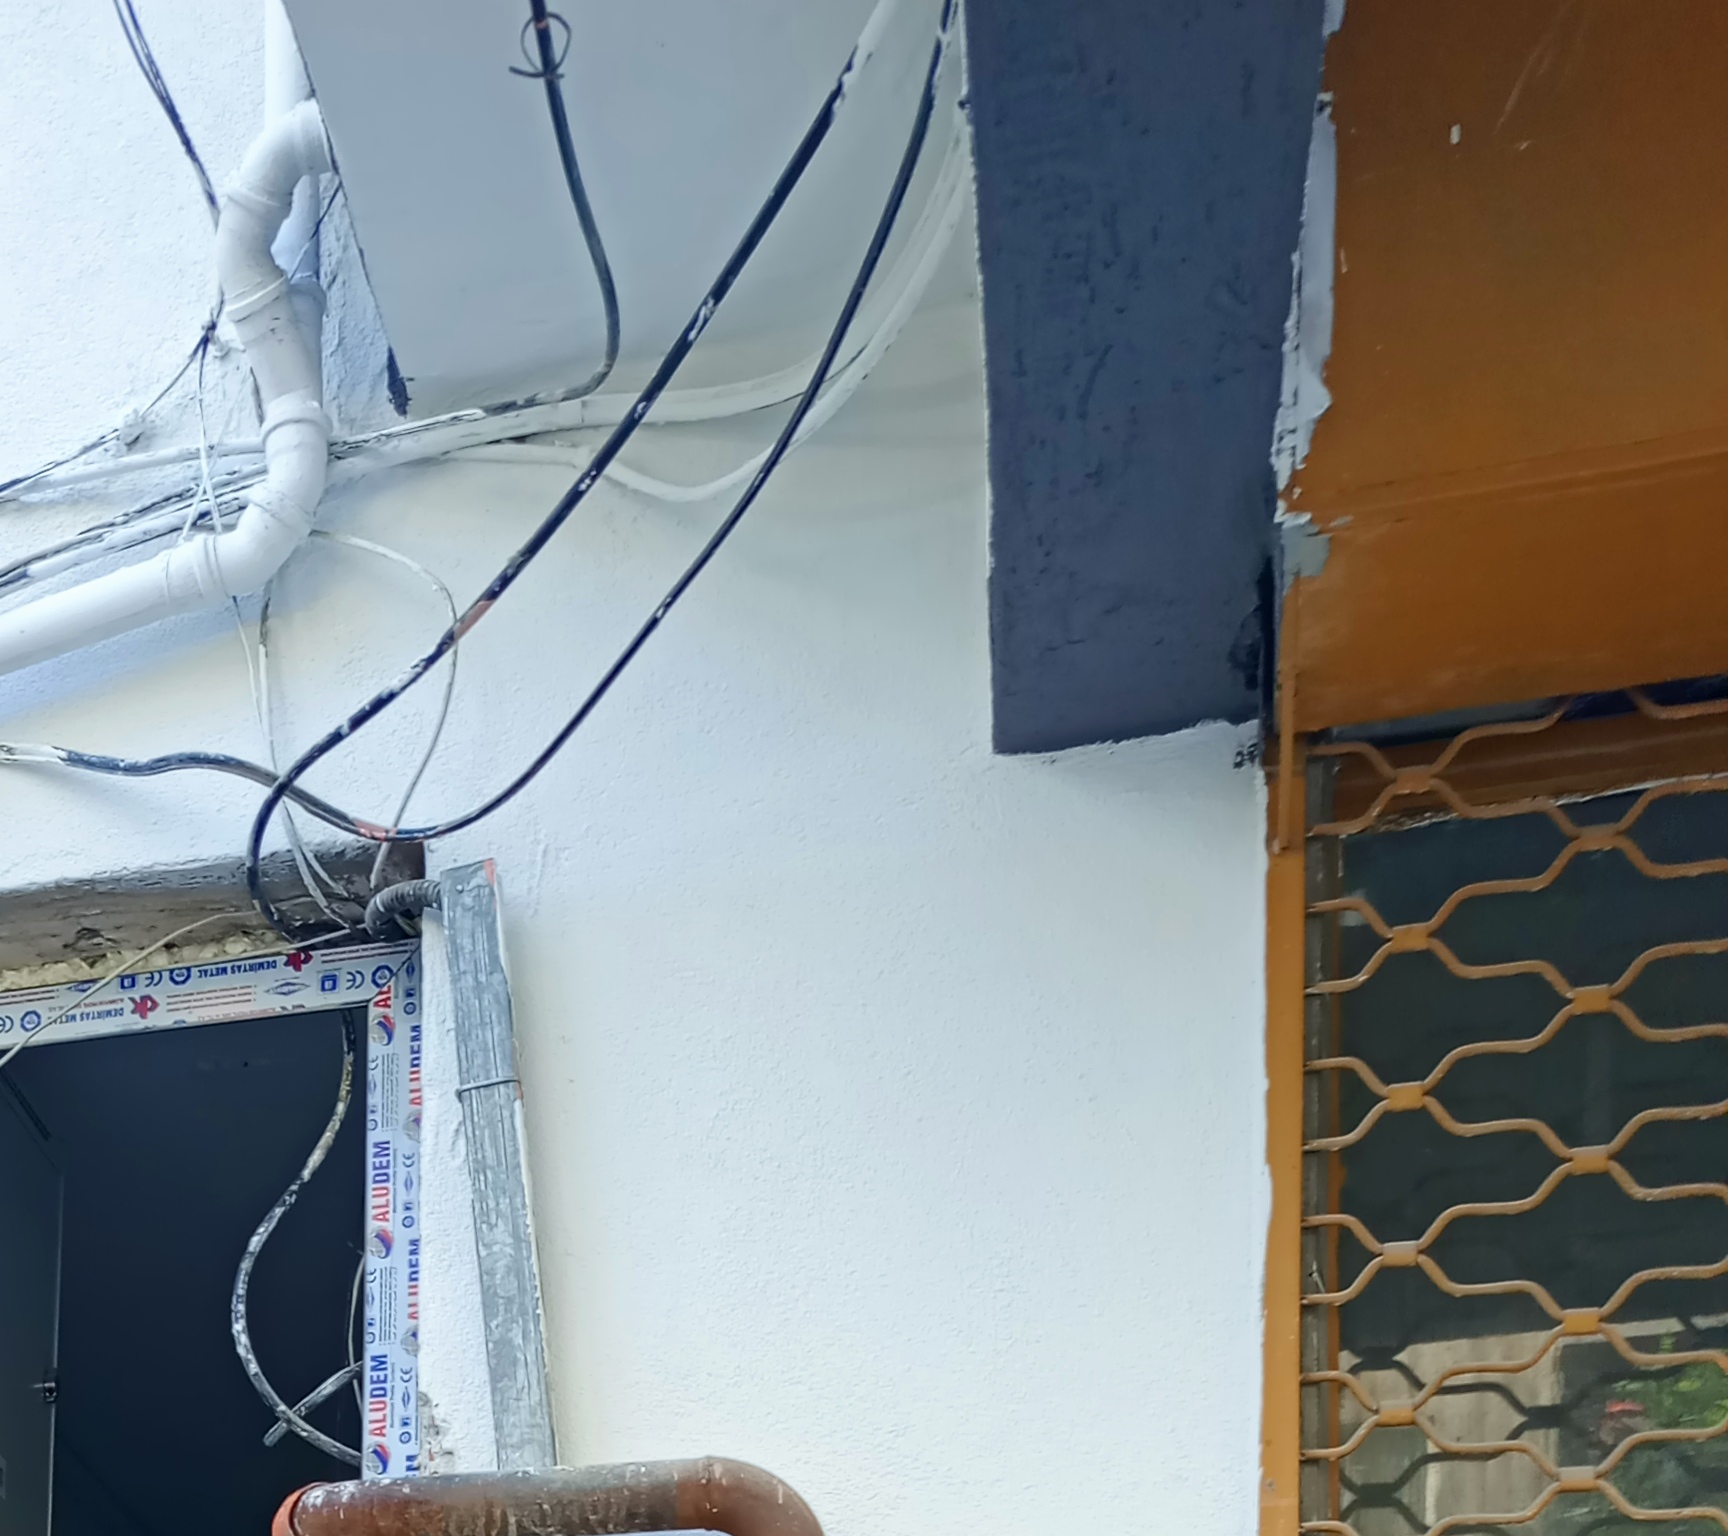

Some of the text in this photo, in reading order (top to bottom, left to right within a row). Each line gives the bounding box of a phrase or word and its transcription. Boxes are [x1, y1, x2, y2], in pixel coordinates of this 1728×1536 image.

[198, 966, 229, 980] METAL
[372, 1141, 391, 1222] ALUDEM
[368, 1355, 387, 1437] ALUDEM
